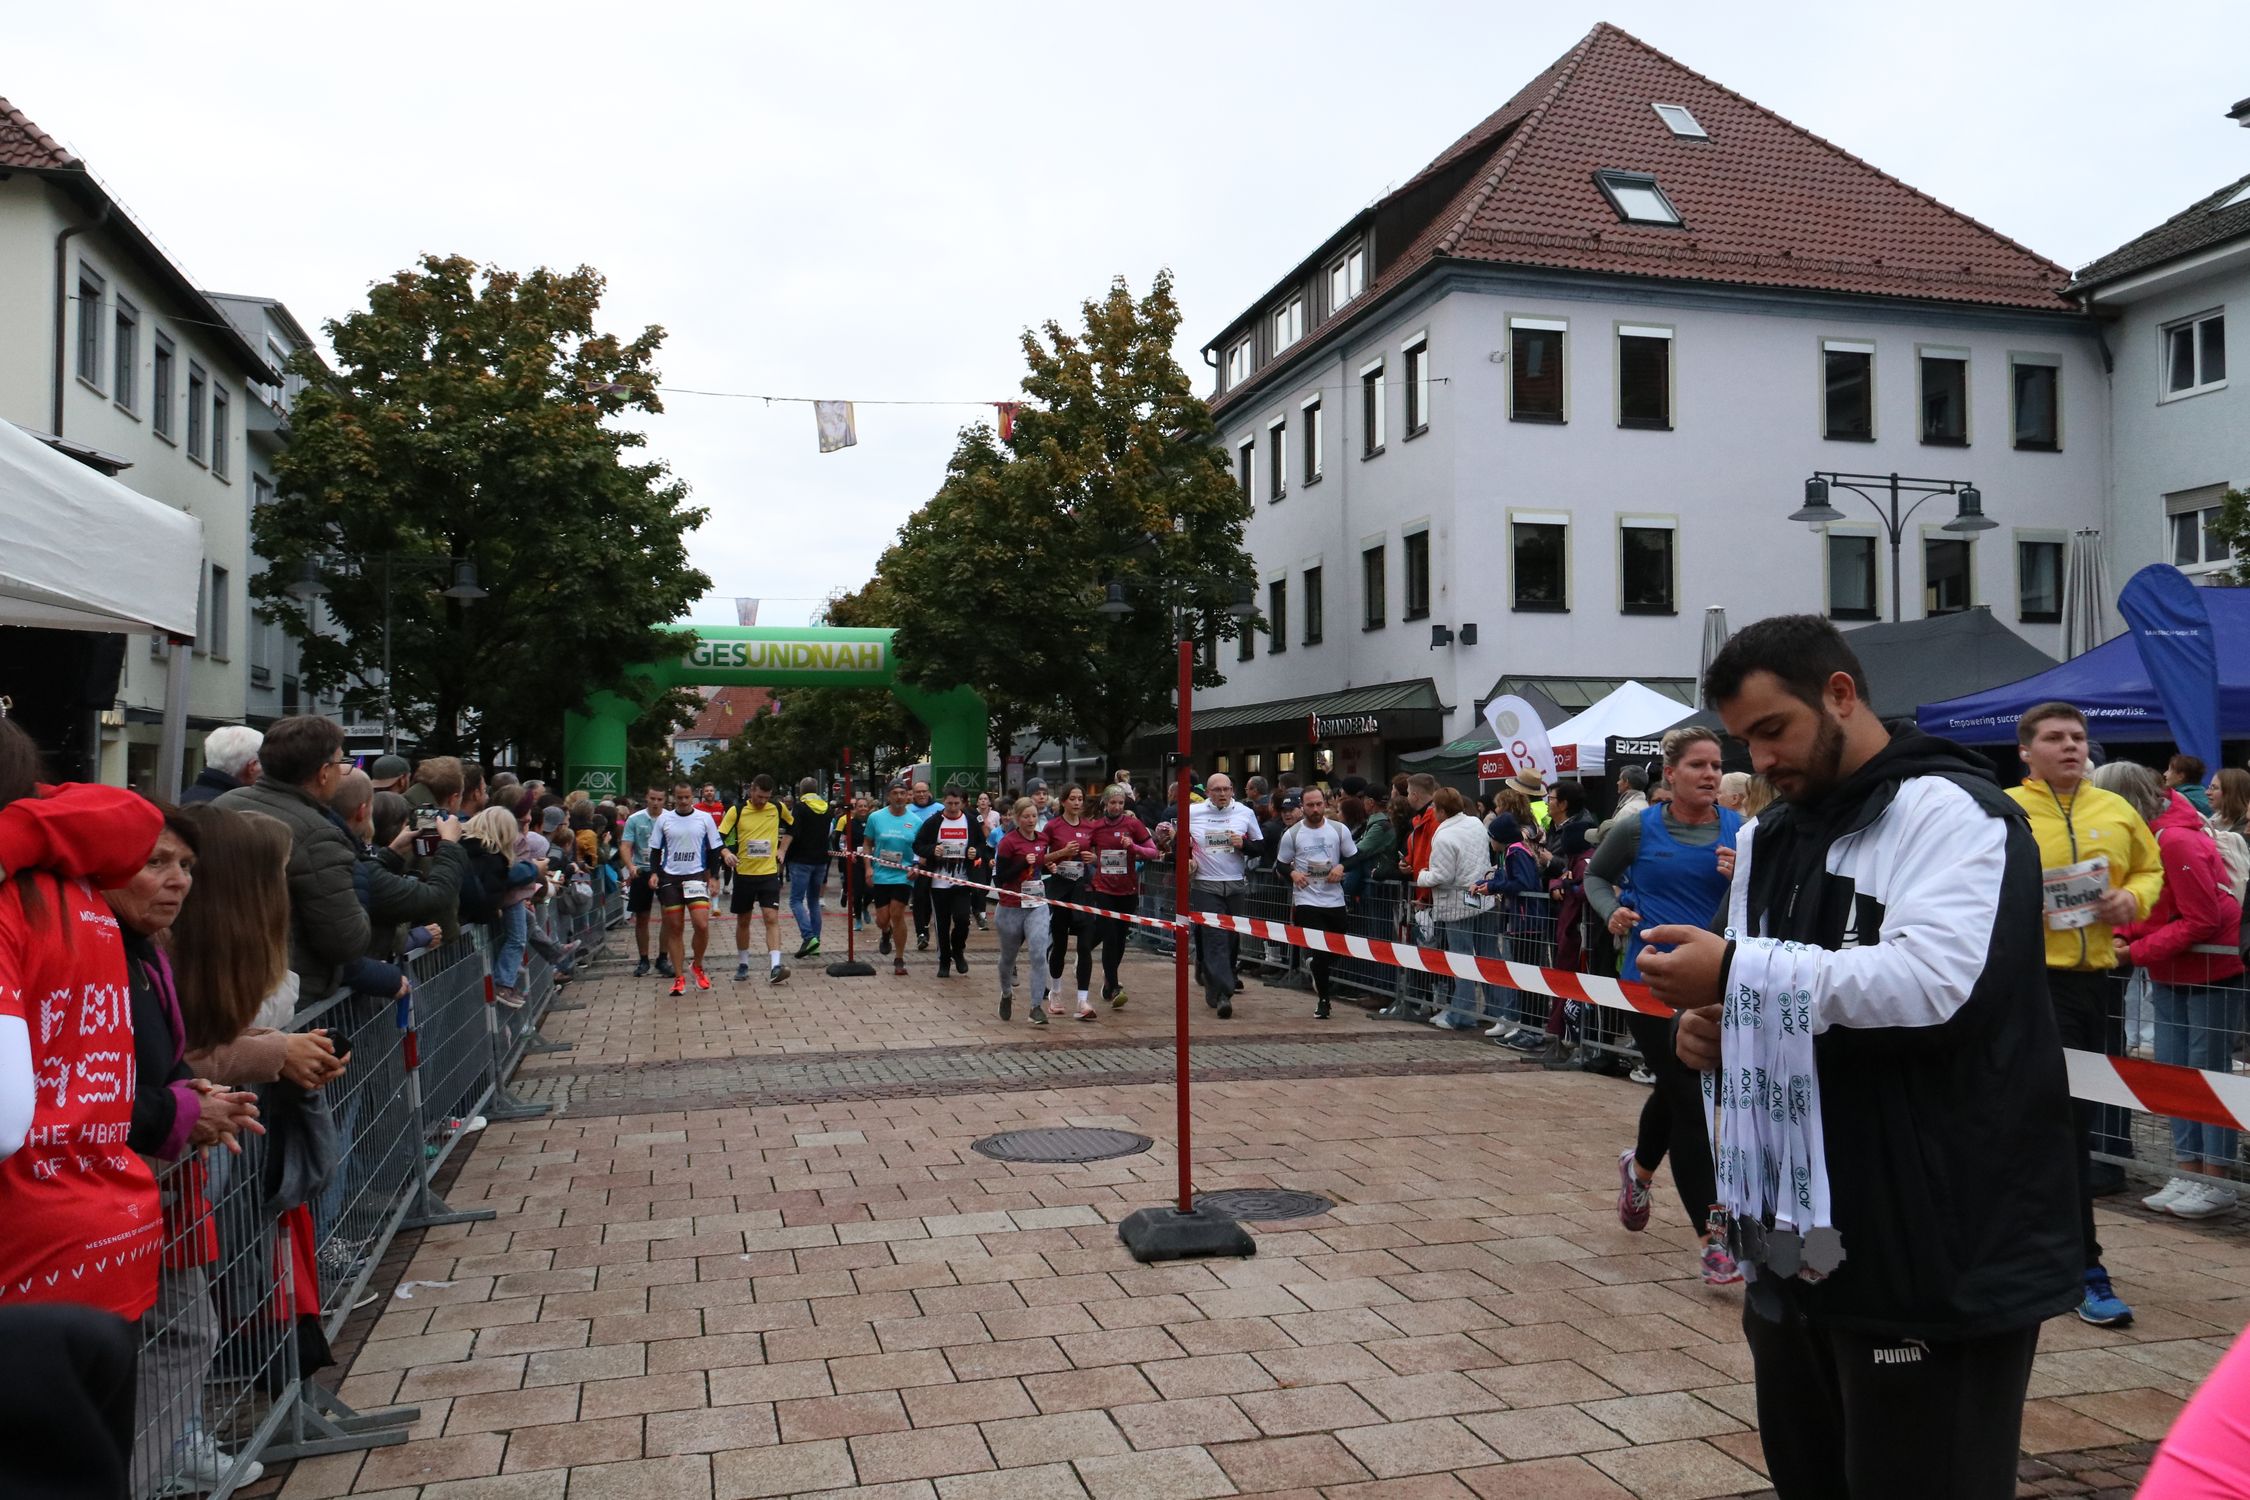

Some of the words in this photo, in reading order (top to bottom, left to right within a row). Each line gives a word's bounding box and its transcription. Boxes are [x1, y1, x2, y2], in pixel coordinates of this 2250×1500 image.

[689, 642, 878, 668] GESUNDNAH
[1950, 715, 1995, 728] Empowering
[2100, 706, 2147, 717] expertise.
[576, 771, 616, 789] AOK
[943, 771, 980, 788] AOK
[673, 852, 696, 862] DAIBER
[1739, 983, 1751, 1011] AOK
[1782, 1008, 1795, 1036] AOK
[1798, 1005, 1809, 1034] AOK
[1703, 1072, 1713, 1099] AOK
[1741, 1067, 1751, 1096] AOK
[1772, 1081, 1783, 1108] AOK
[1795, 1089, 1807, 1117] AOK
[1799, 1181, 1811, 1210] AOK
[86, 1231, 132, 1250] MESSENGERS
[1873, 1347, 1922, 1364] PUMA
